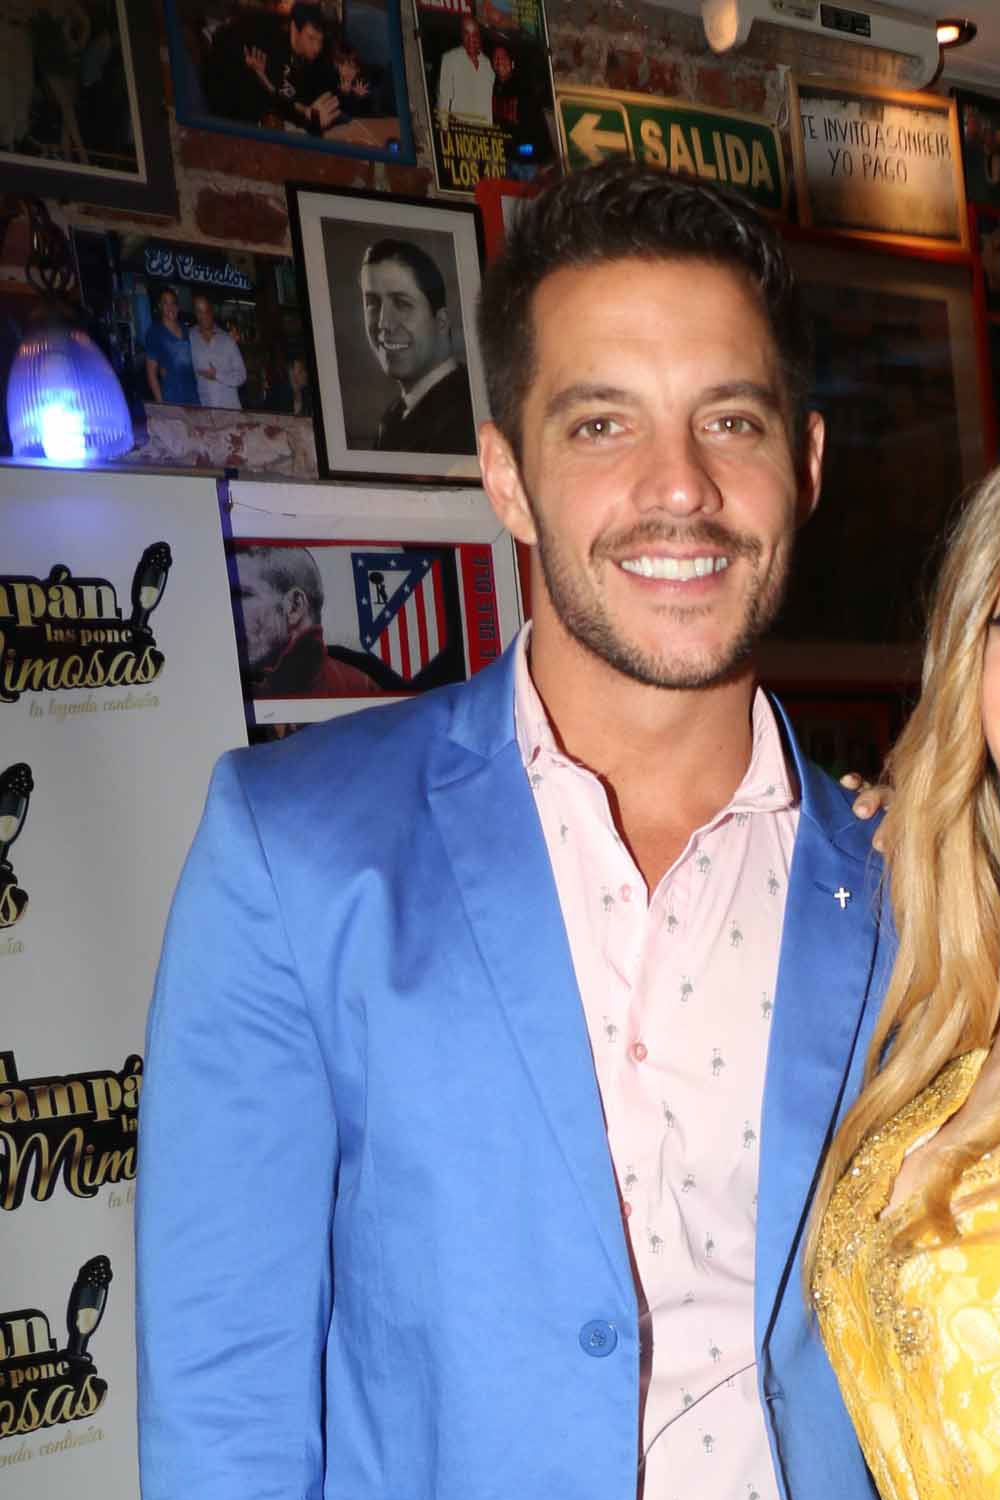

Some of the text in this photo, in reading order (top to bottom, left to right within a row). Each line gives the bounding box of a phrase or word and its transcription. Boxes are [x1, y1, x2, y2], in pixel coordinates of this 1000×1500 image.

[440, 130, 506, 164] LA NOCHE DE
[800, 114, 818, 140] TE
[823, 116, 871, 148] INVITO
[640, 118, 775, 192] SALIDA
[828, 148, 908, 184] YO PAGO
[80, 628, 133, 647] pone
[0, 645, 157, 702] imosas
[0, 1127, 138, 1211] Mim
[8, 1360, 71, 1389] pone
